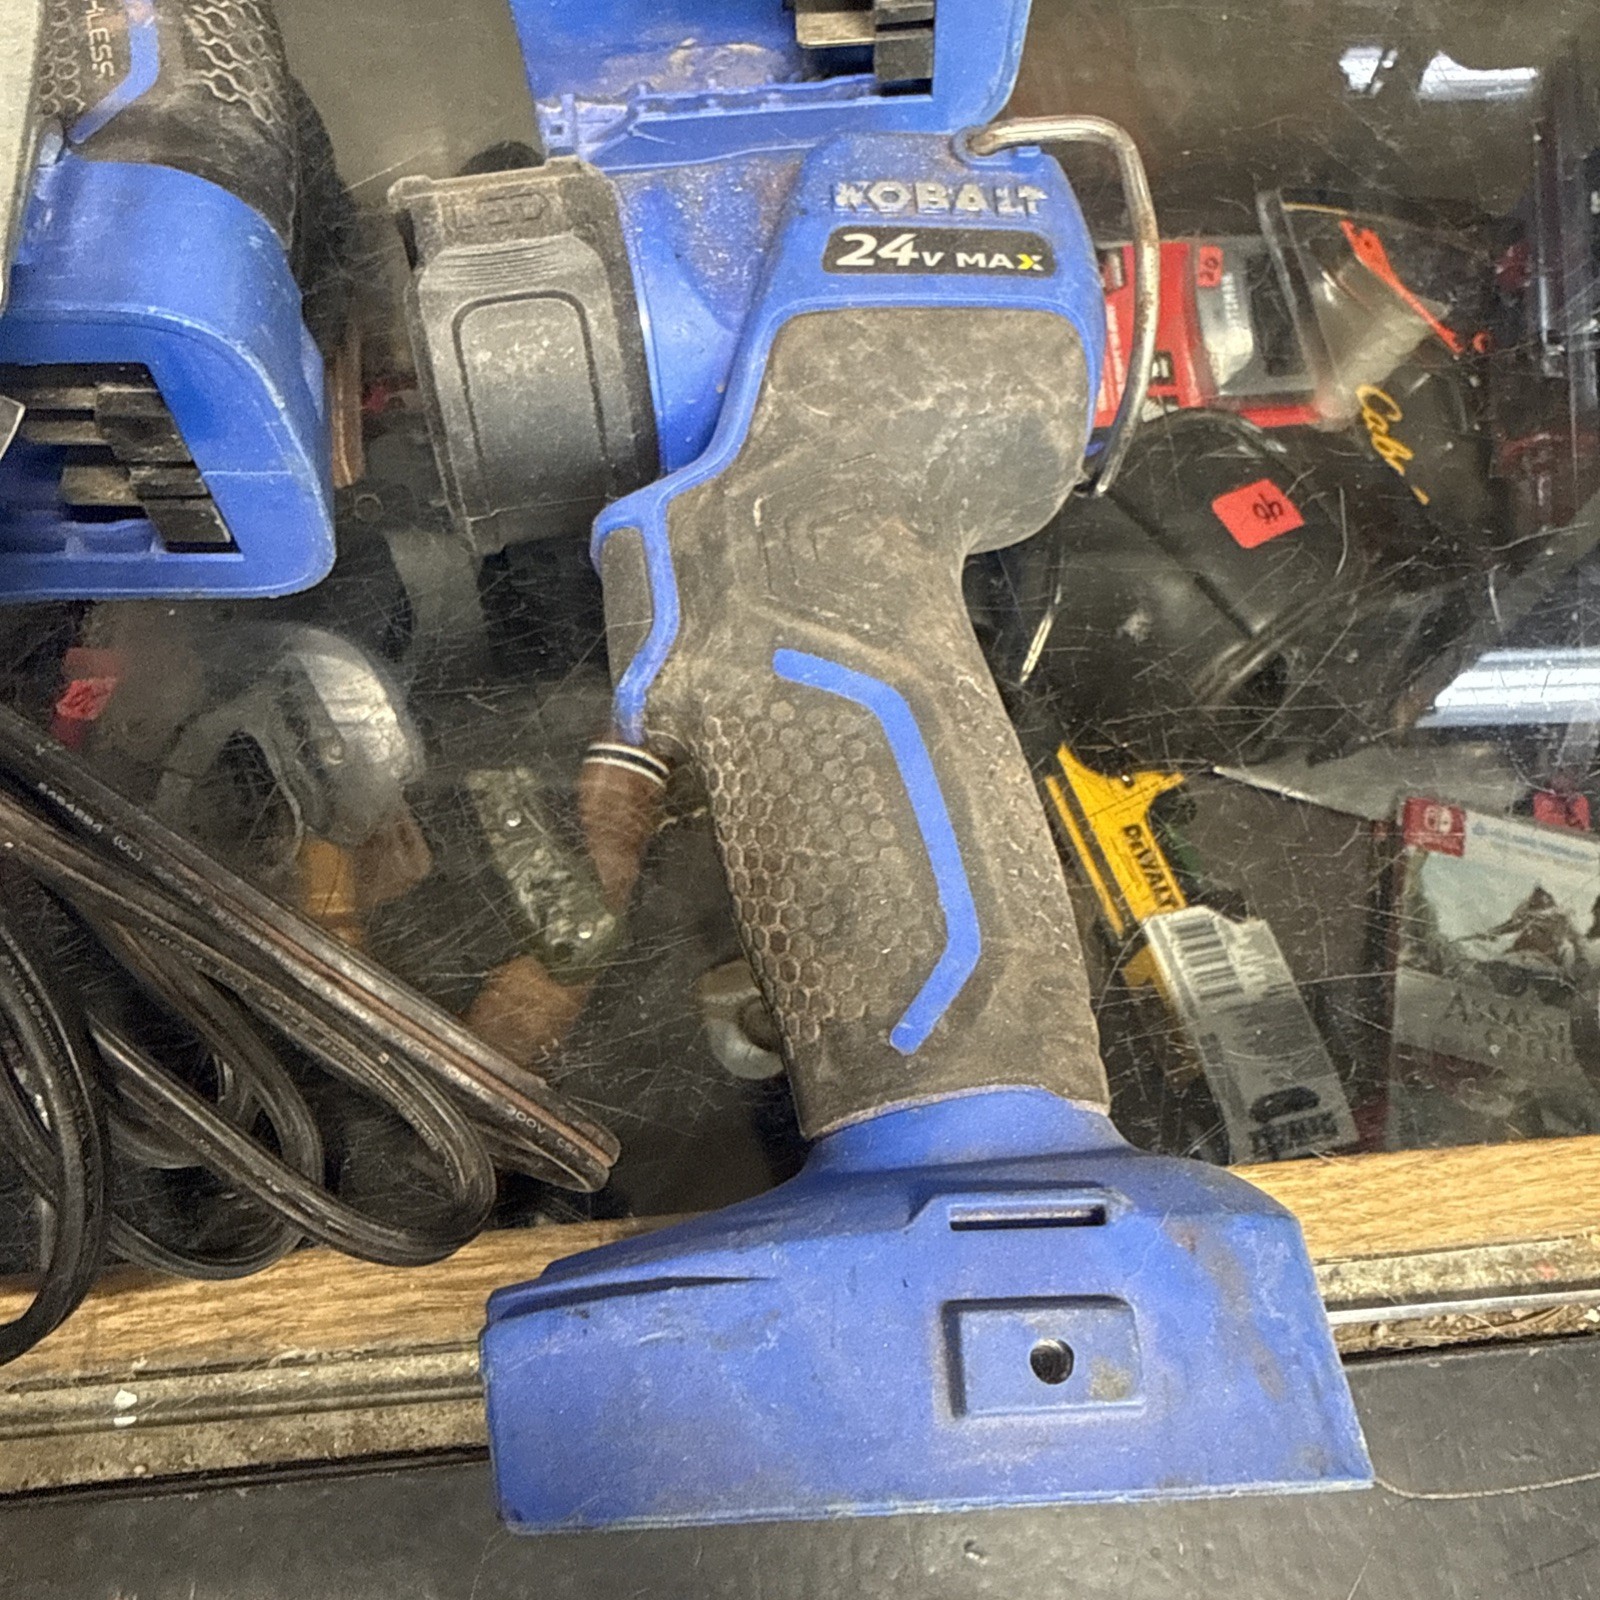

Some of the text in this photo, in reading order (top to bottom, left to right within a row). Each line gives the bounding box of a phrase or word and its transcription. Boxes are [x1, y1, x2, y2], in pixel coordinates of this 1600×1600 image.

[450, 191, 551, 230] LED
[831, 180, 1048, 217] KOBALT
[956, 252, 1044, 271] MAX
[1123, 824, 1179, 908] DEWALT
[504, 1103, 547, 1135] 300V
